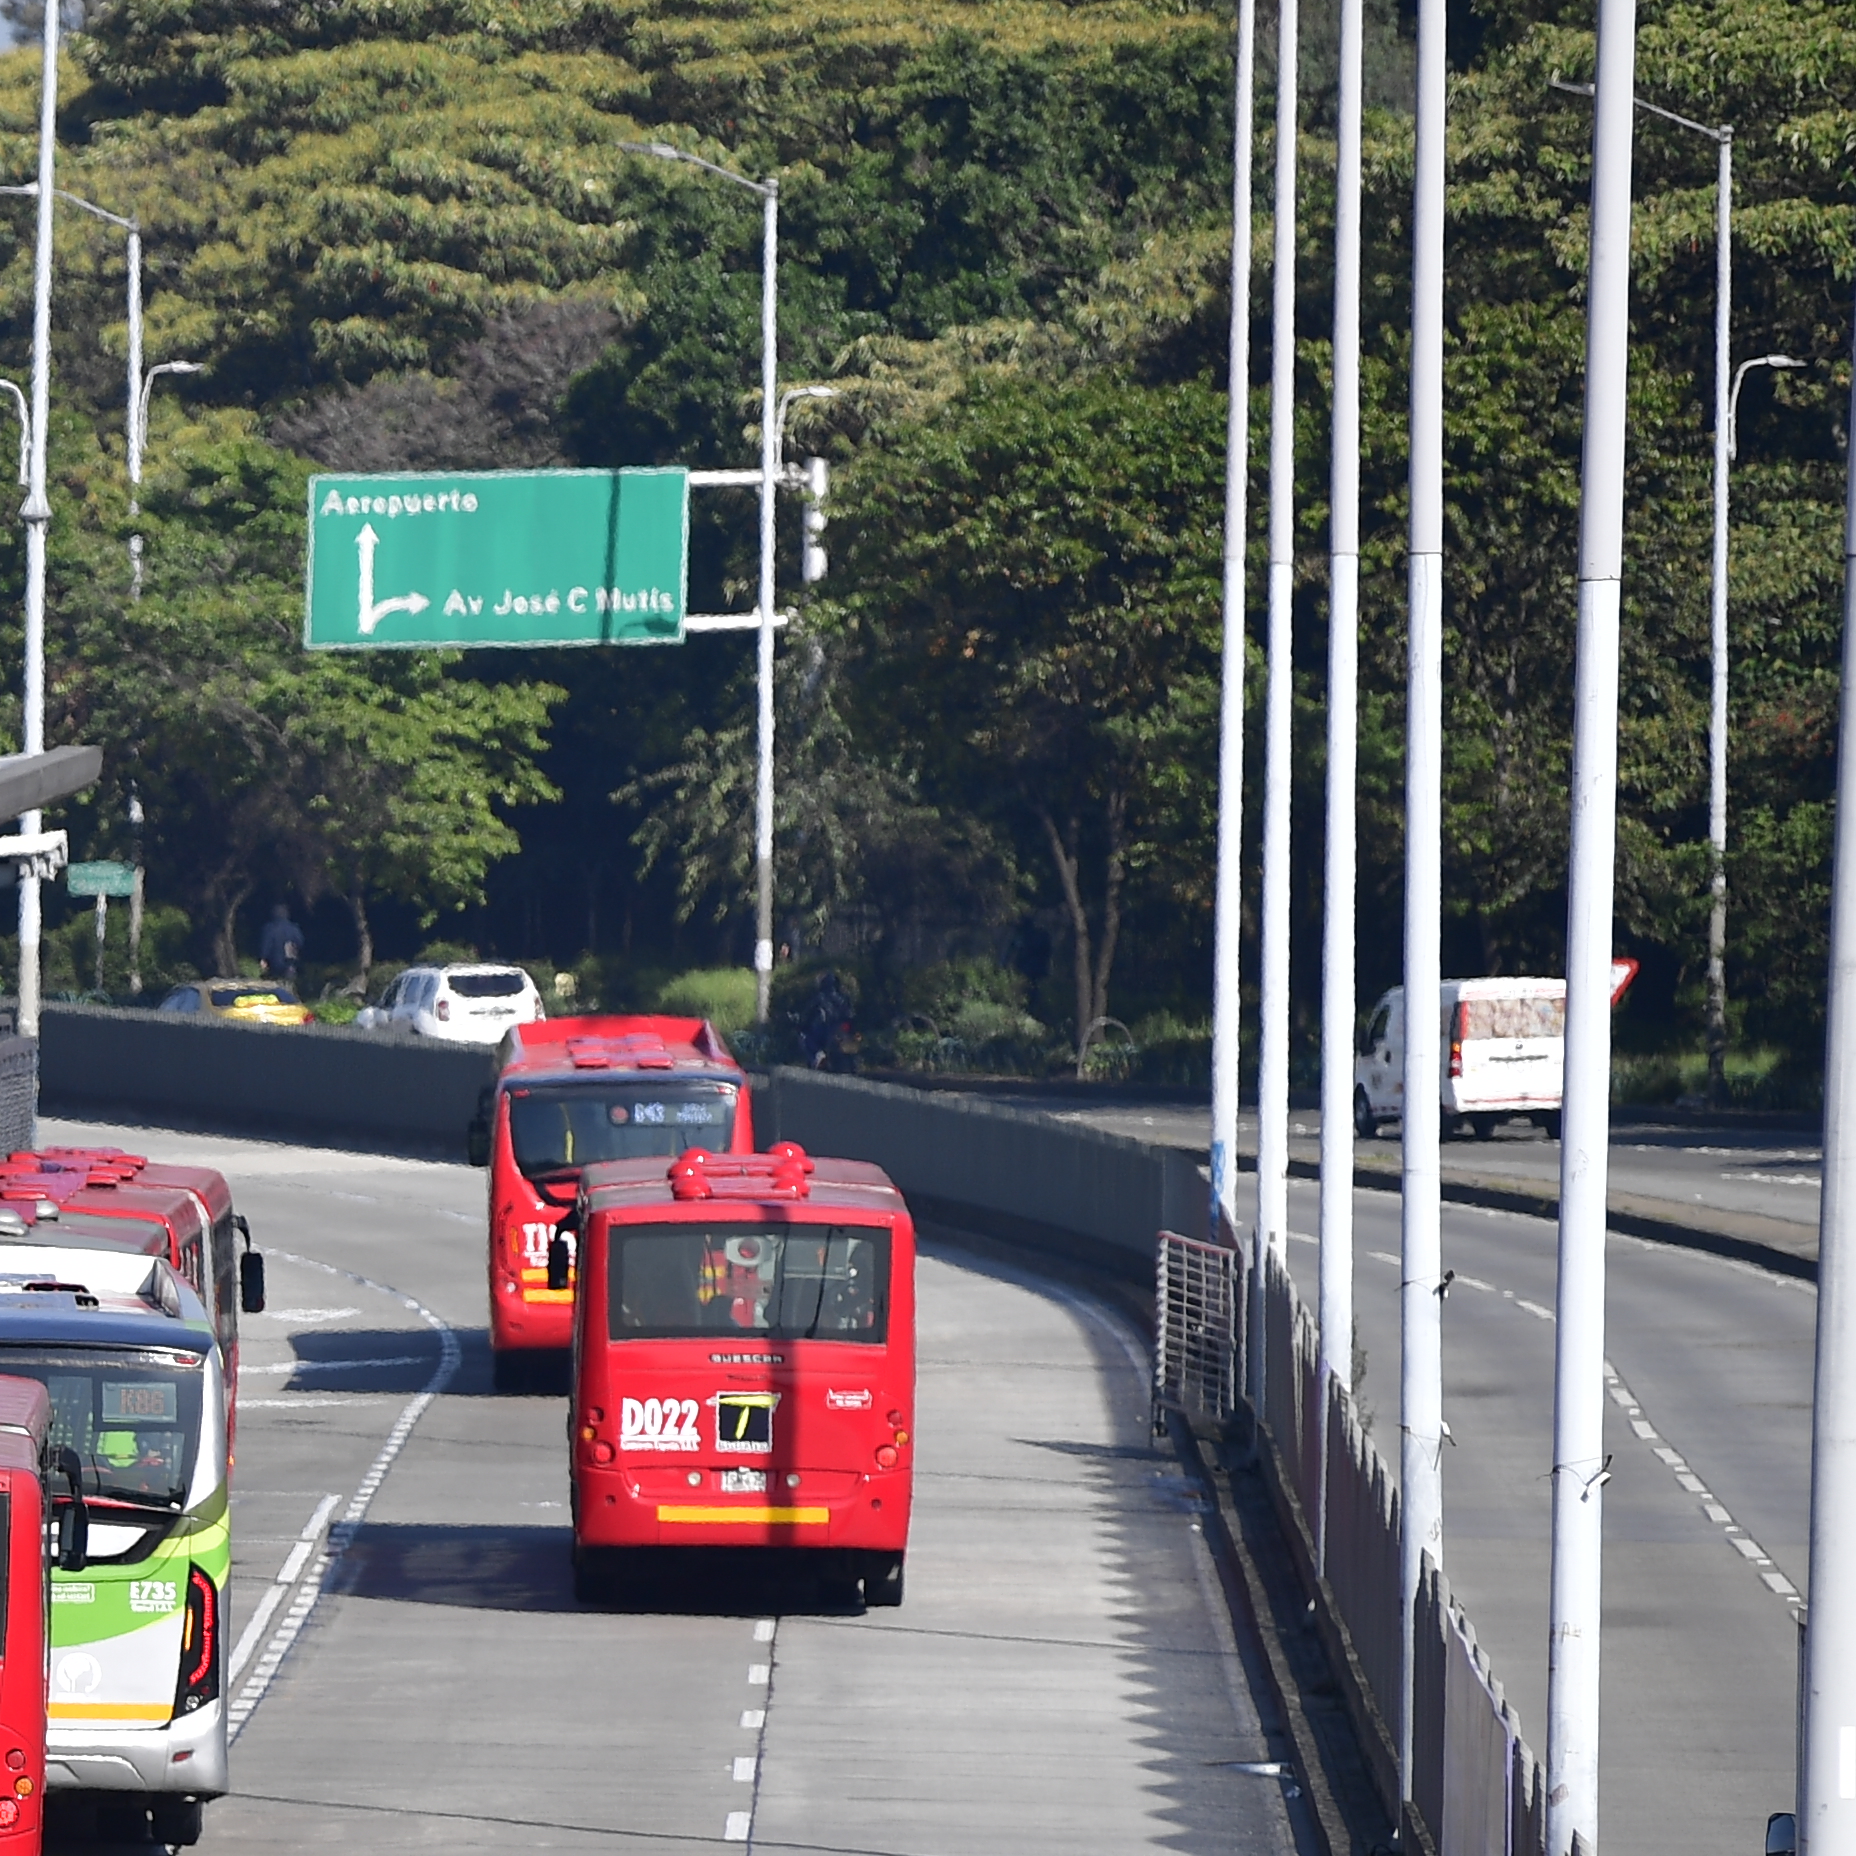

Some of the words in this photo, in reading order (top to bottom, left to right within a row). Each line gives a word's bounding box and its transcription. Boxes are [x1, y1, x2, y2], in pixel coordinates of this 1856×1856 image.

[320, 488, 478, 517] Aeropuerto
[442, 589, 483, 616] Av
[494, 586, 560, 616] José
[568, 587, 588, 614] C
[596, 586, 674, 614] Mutis
[120, 1389, 164, 1414] K86
[621, 1397, 699, 1435] D022
[130, 1581, 176, 1600] E735
